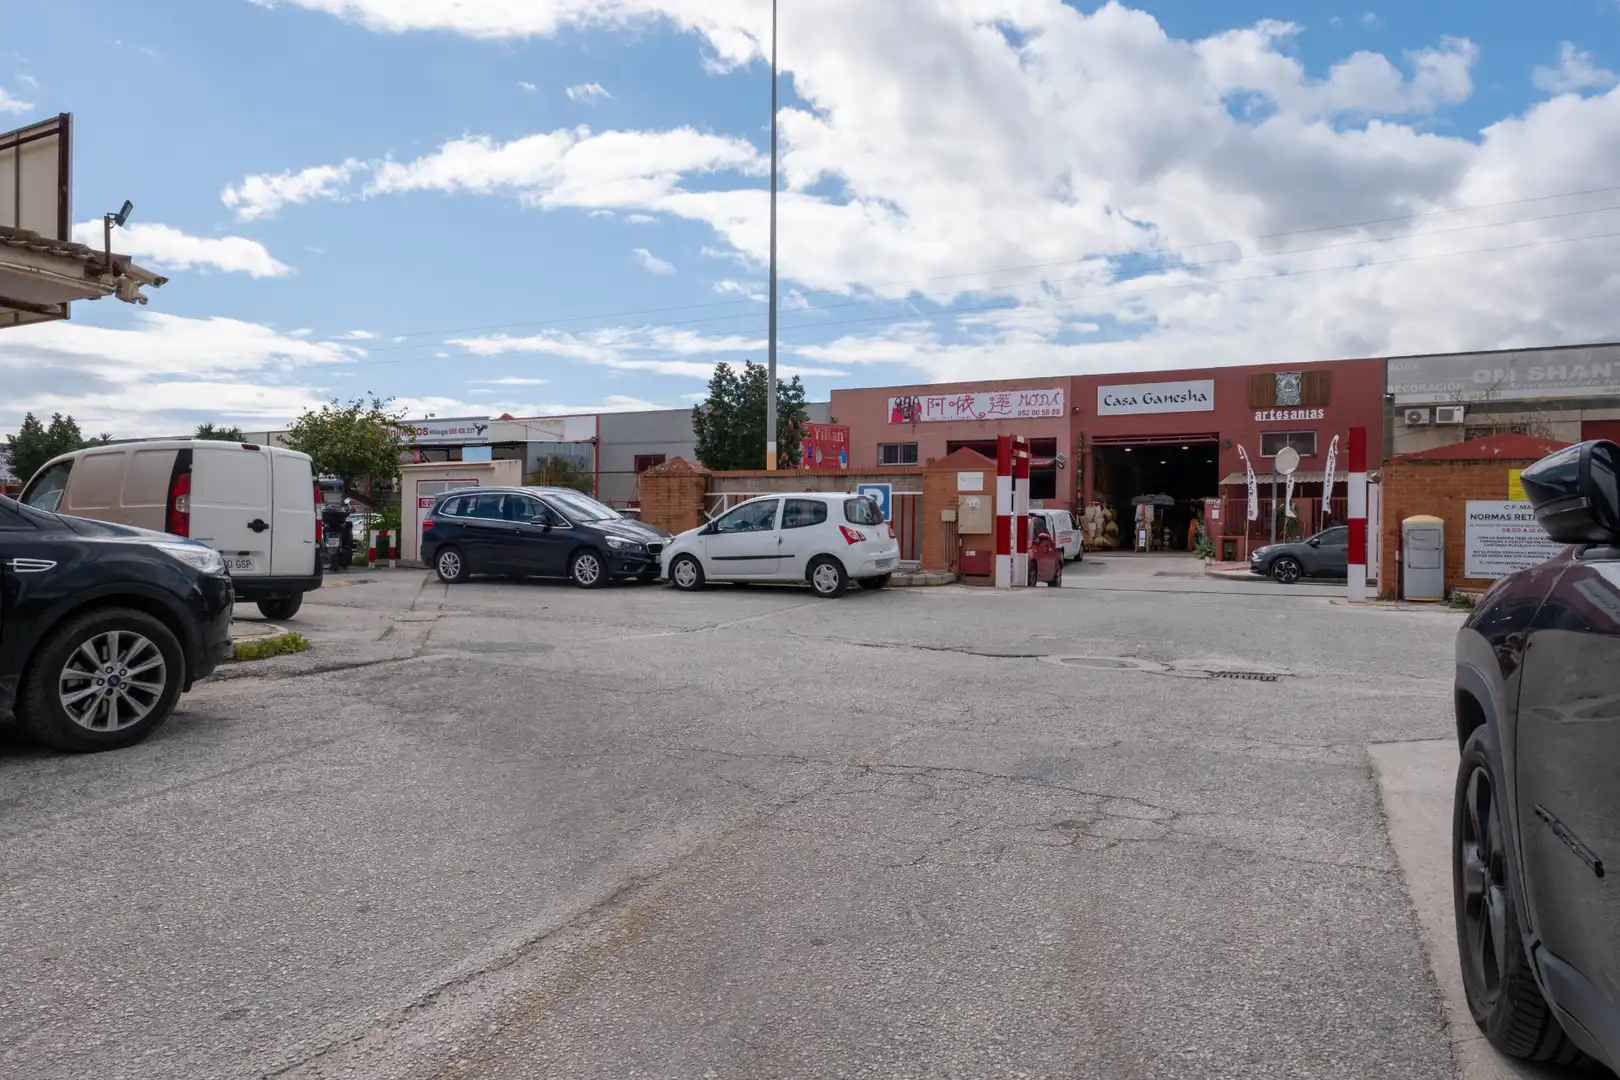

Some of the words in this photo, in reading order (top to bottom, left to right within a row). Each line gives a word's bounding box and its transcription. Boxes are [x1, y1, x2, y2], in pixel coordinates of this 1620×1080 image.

[1471, 369, 1516, 384] OM
[1103, 394, 1138, 407] Casa
[1142, 389, 1208, 405] Ganesha
[1470, 513, 1512, 521] NORMAS
[1514, 513, 1536, 521] RETI
[236, 559, 251, 569] GSP
